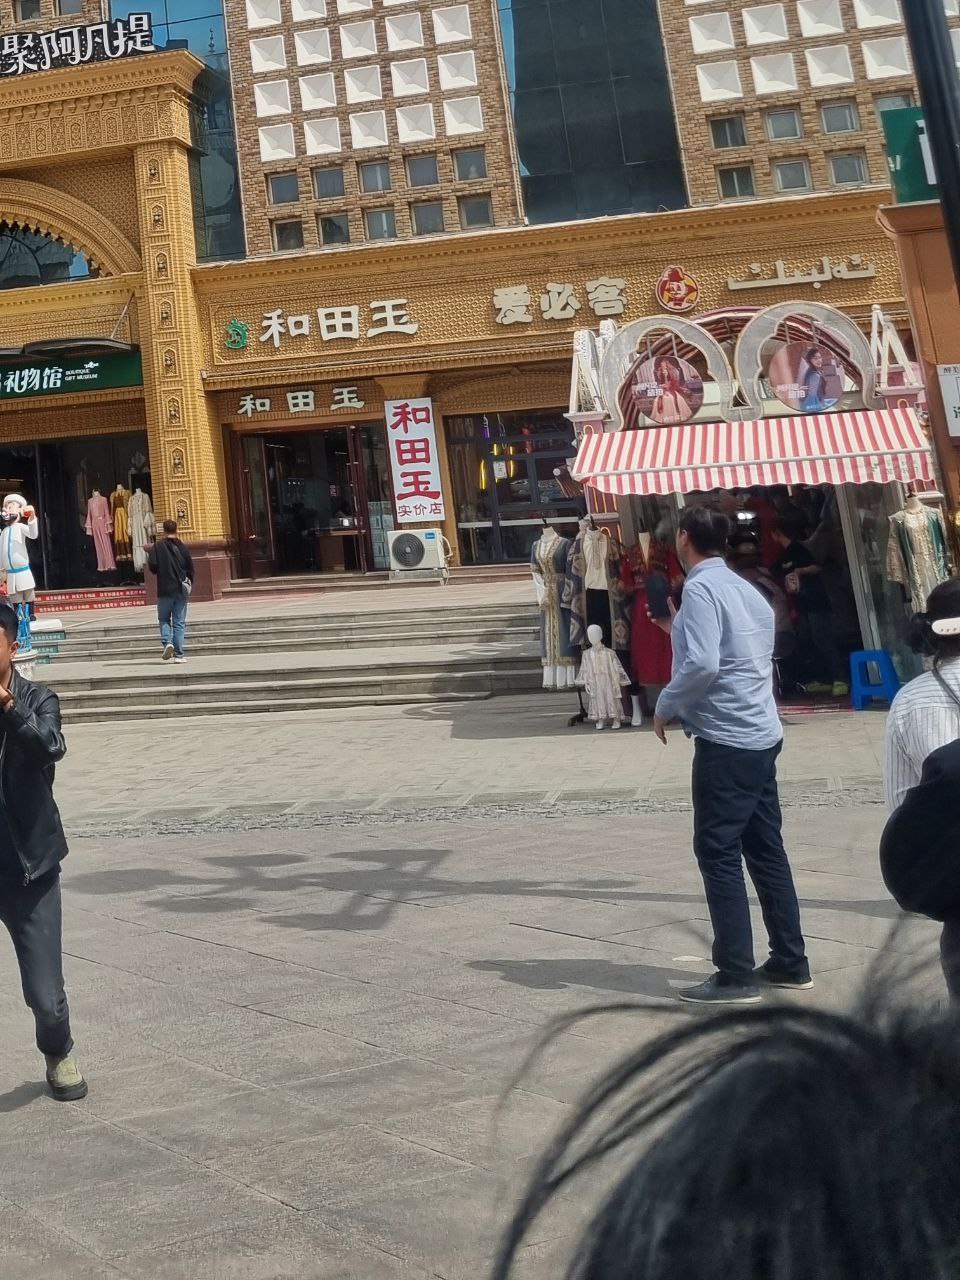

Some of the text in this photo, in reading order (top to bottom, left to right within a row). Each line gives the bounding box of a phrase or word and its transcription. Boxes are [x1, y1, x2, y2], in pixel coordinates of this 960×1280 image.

[259, 298, 419, 348] 和田玉
[493, 276, 627, 325] 爱必客
[237, 386, 365, 418] 和田玉
[390, 402, 441, 501] 和田玉
[397, 501, 443, 517] 实价店
